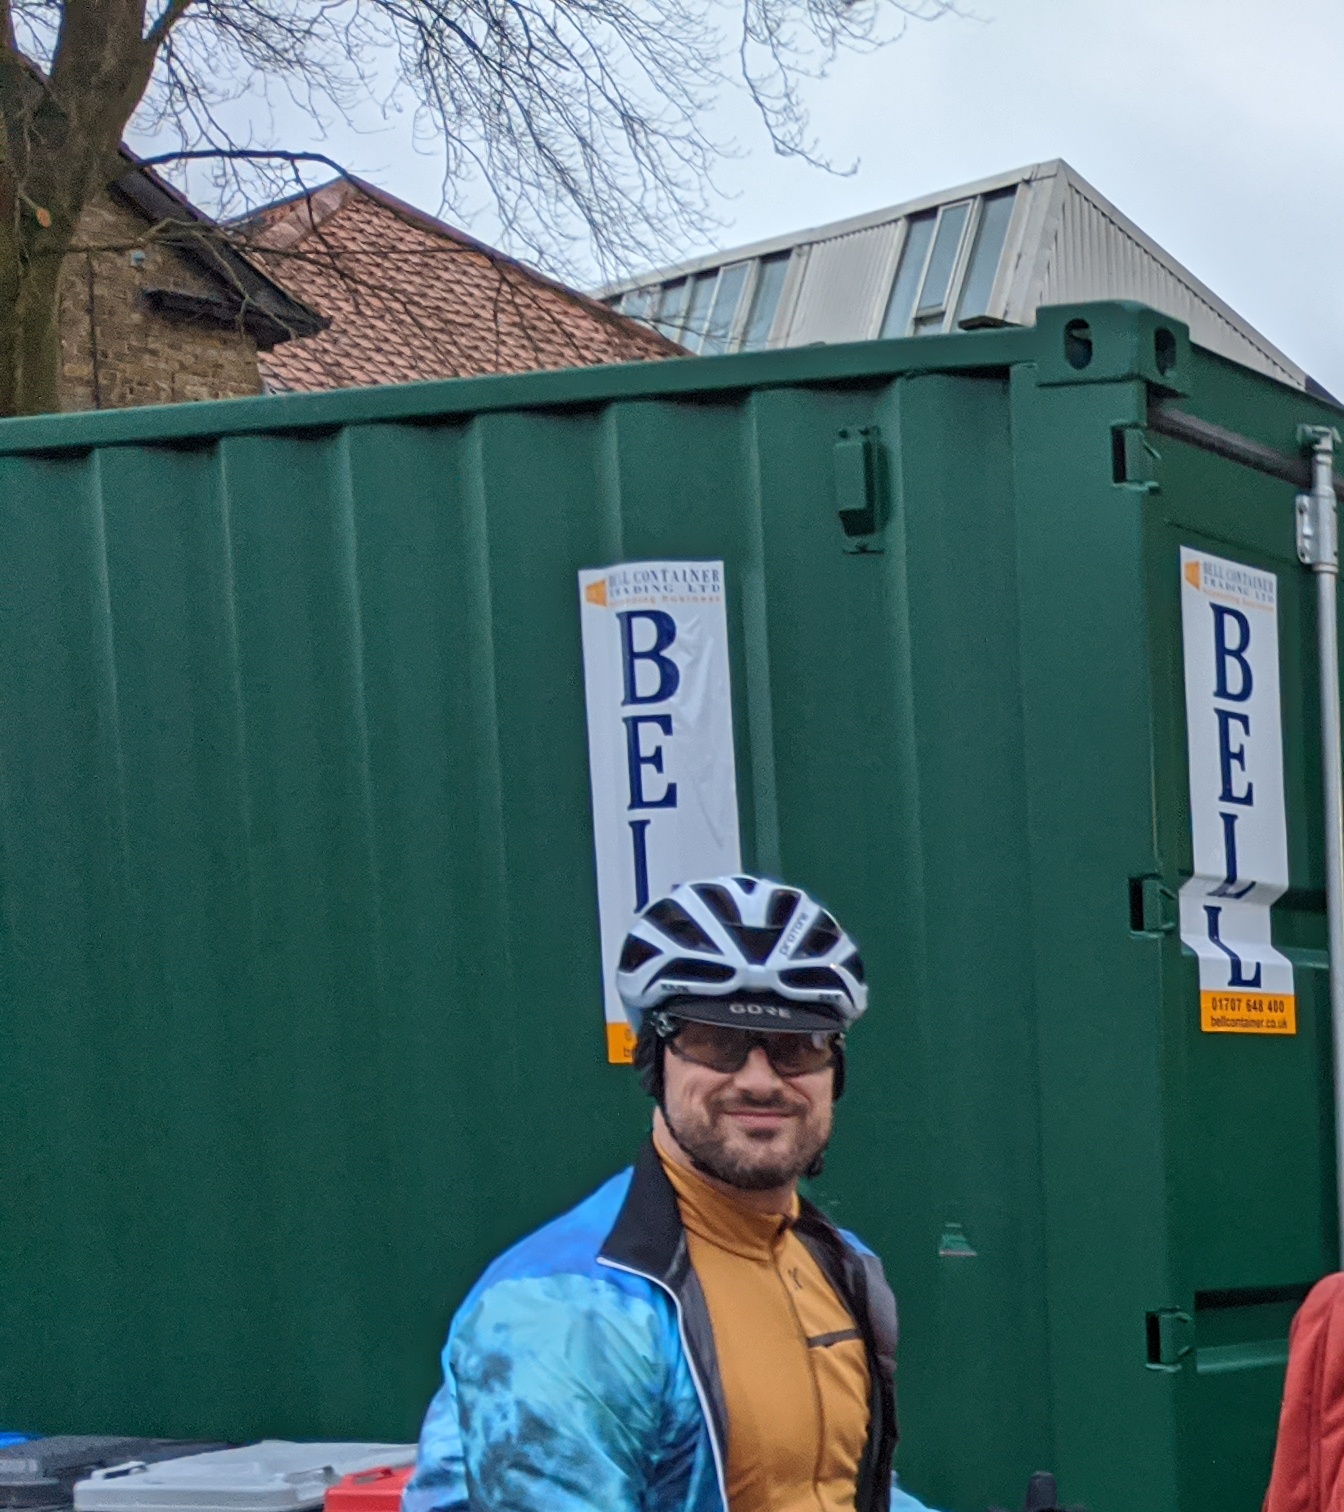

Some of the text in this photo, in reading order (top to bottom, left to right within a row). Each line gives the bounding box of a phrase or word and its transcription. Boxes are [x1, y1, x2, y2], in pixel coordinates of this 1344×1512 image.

[633, 569, 720, 585] CONTAINER
[687, 583, 721, 594] LTD
[1203, 602, 1262, 989] BELL
[729, 1002, 792, 1020] GORE
[1211, 997, 1242, 1013] 01707
